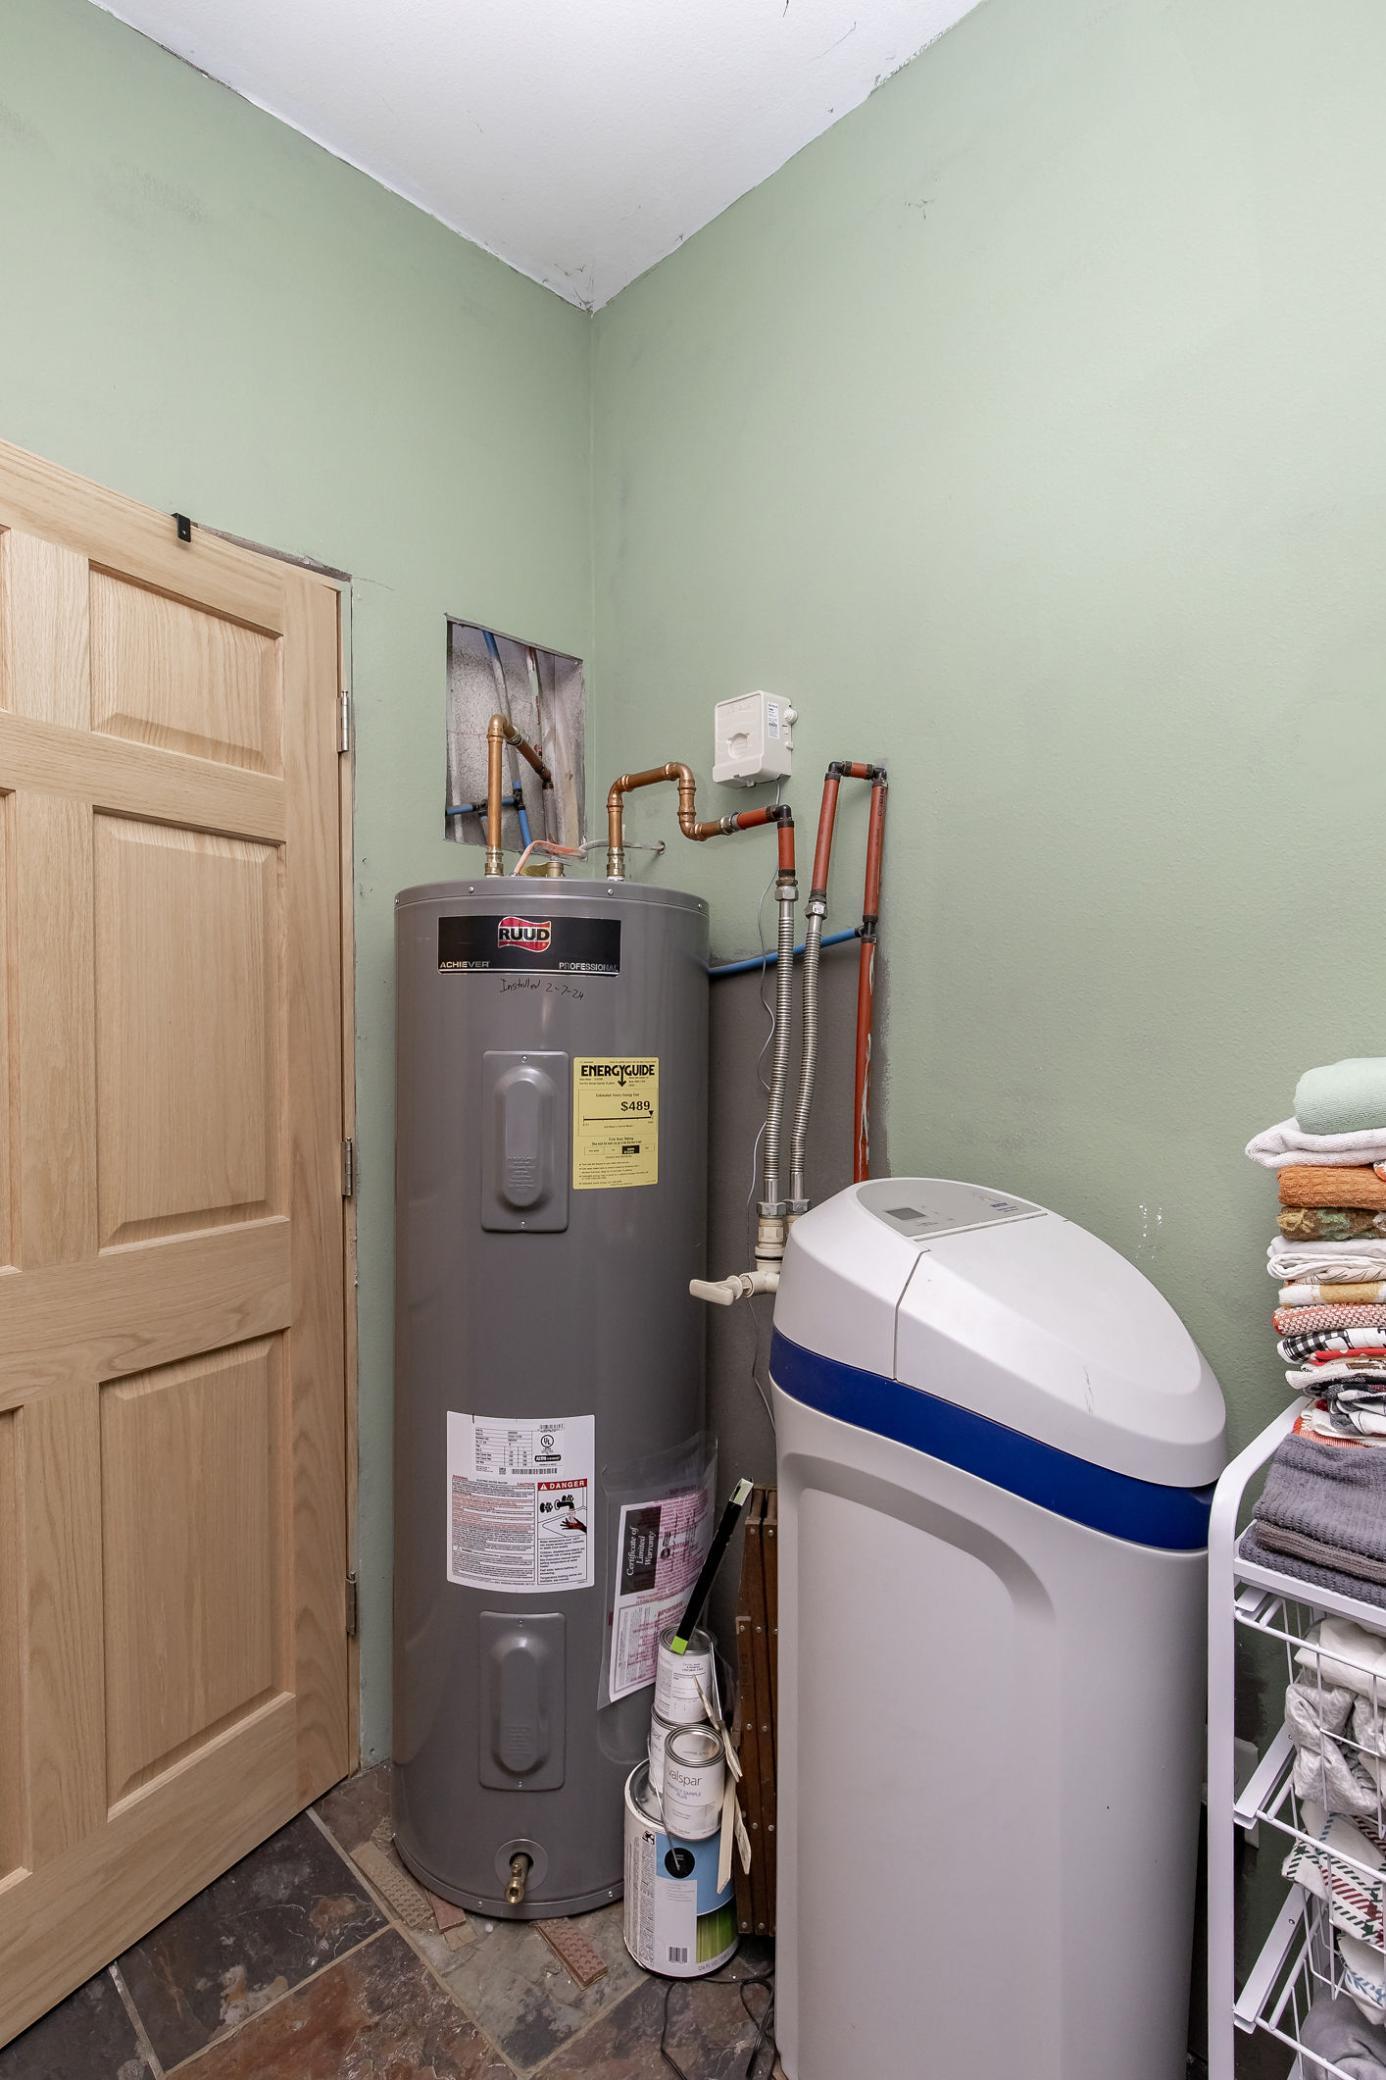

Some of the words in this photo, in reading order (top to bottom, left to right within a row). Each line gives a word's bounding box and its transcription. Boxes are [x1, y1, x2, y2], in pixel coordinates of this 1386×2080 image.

[498, 927, 551, 942] RUUD
[439, 961, 490, 969] ACHIEVER
[558, 962, 618, 973] PROFESSIONAL
[499, 978, 541, 993] Installed
[545, 982, 585, 1001] 2-7-24
[581, 1063, 656, 1077] ENERGYGUIDE
[549, 1480, 585, 1490] DANGER
[636, 1535, 645, 1565] Limited
[644, 1531, 657, 1566] Warranty
[626, 1540, 637, 1576] Certificate
